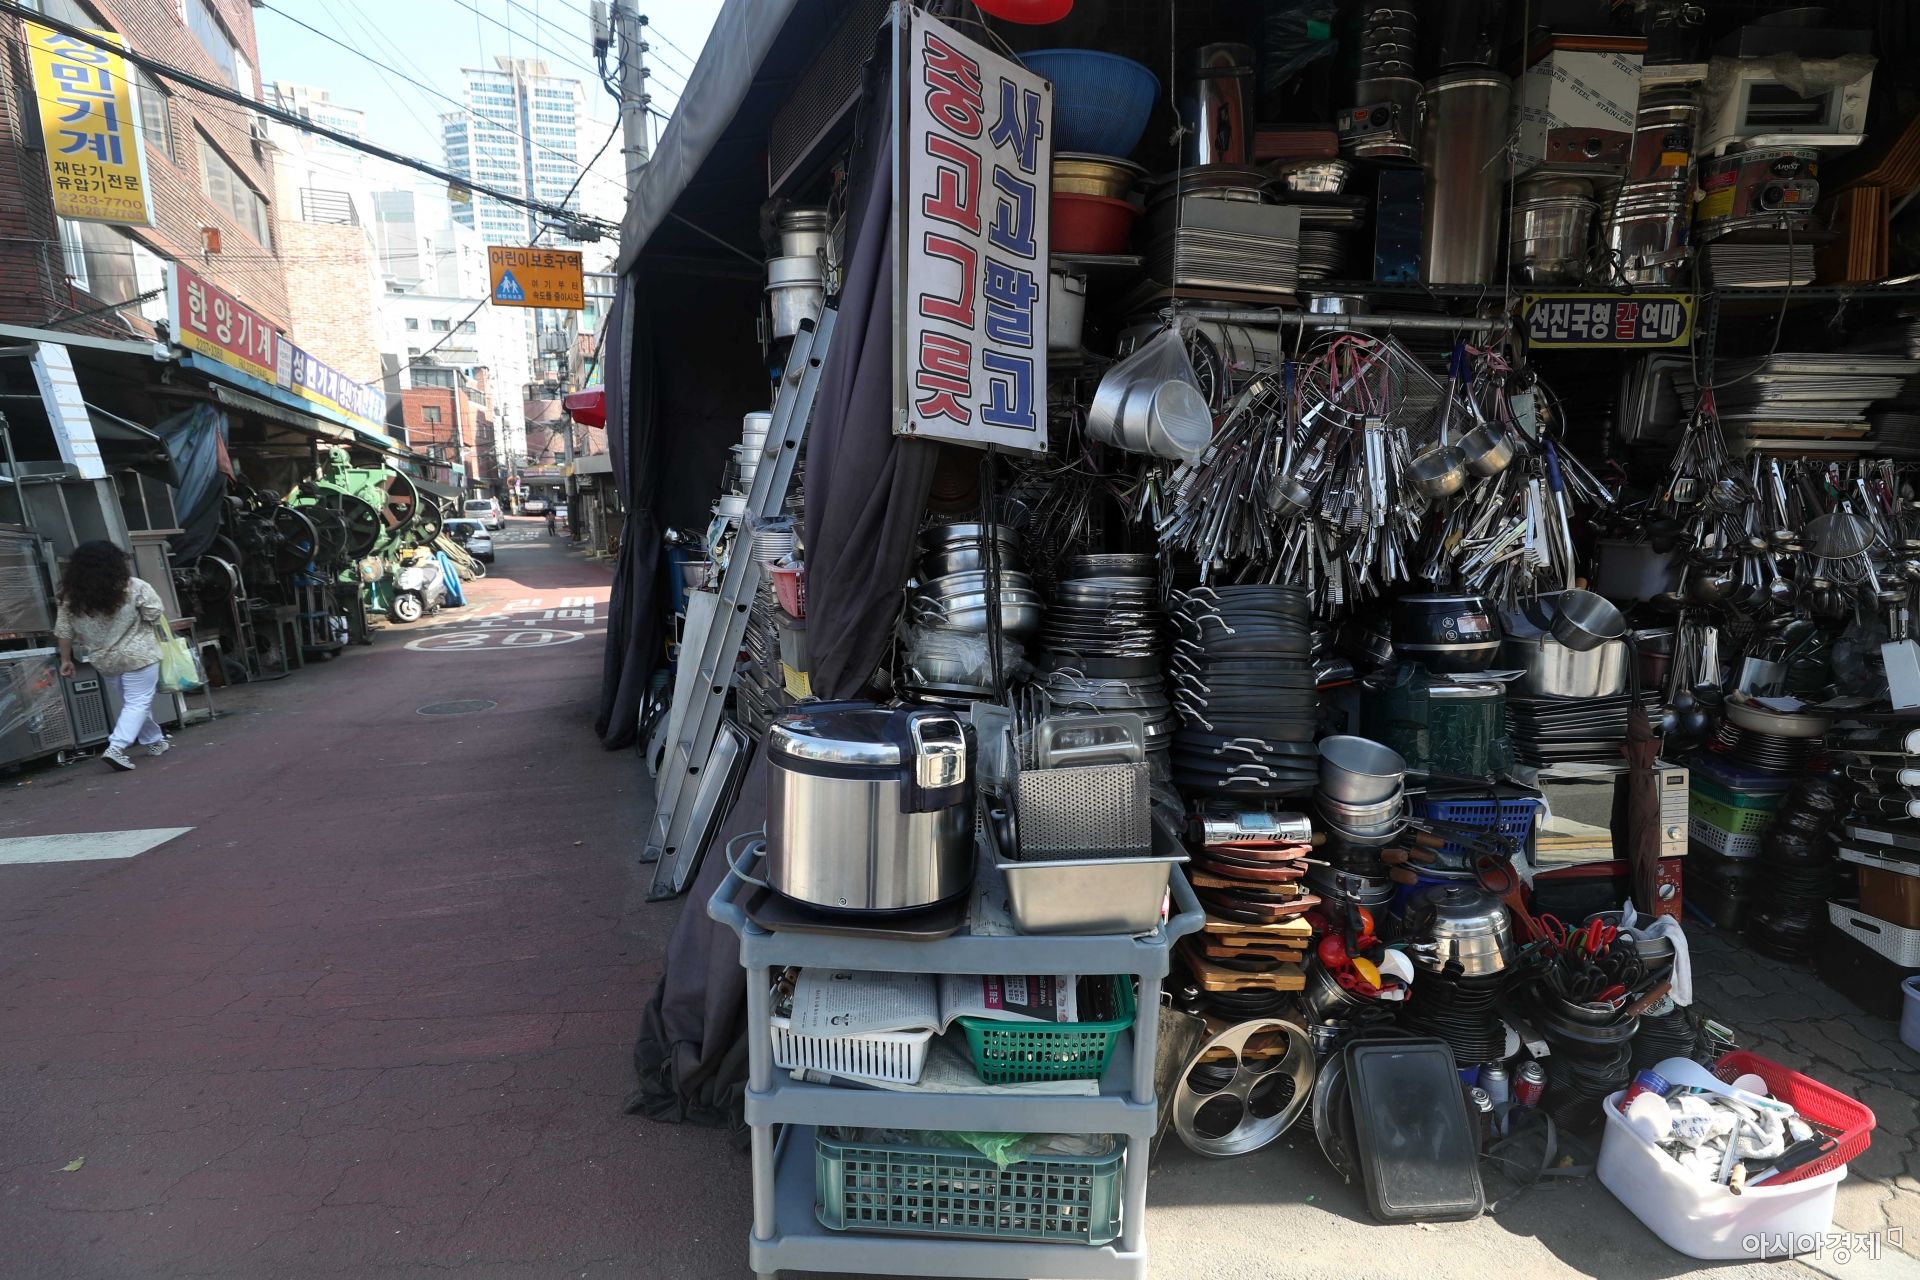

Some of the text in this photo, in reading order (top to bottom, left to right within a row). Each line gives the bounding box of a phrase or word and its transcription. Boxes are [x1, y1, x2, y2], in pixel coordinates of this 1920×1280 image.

[1596, 101, 1633, 127] STAINLESS
[54, 161, 104, 179] 재단기
[56, 176, 106, 194] 유압기
[107, 173, 139, 191] 전문
[916, 29, 985, 425] 중고그릇
[492, 251, 579, 270] 어린이보호구역
[979, 75, 1043, 431] 사고팔고
[187, 280, 271, 366] 한양기계
[1530, 302, 1681, 340] 선진국형 칼 연마
[432, 631, 553, 649] 30
